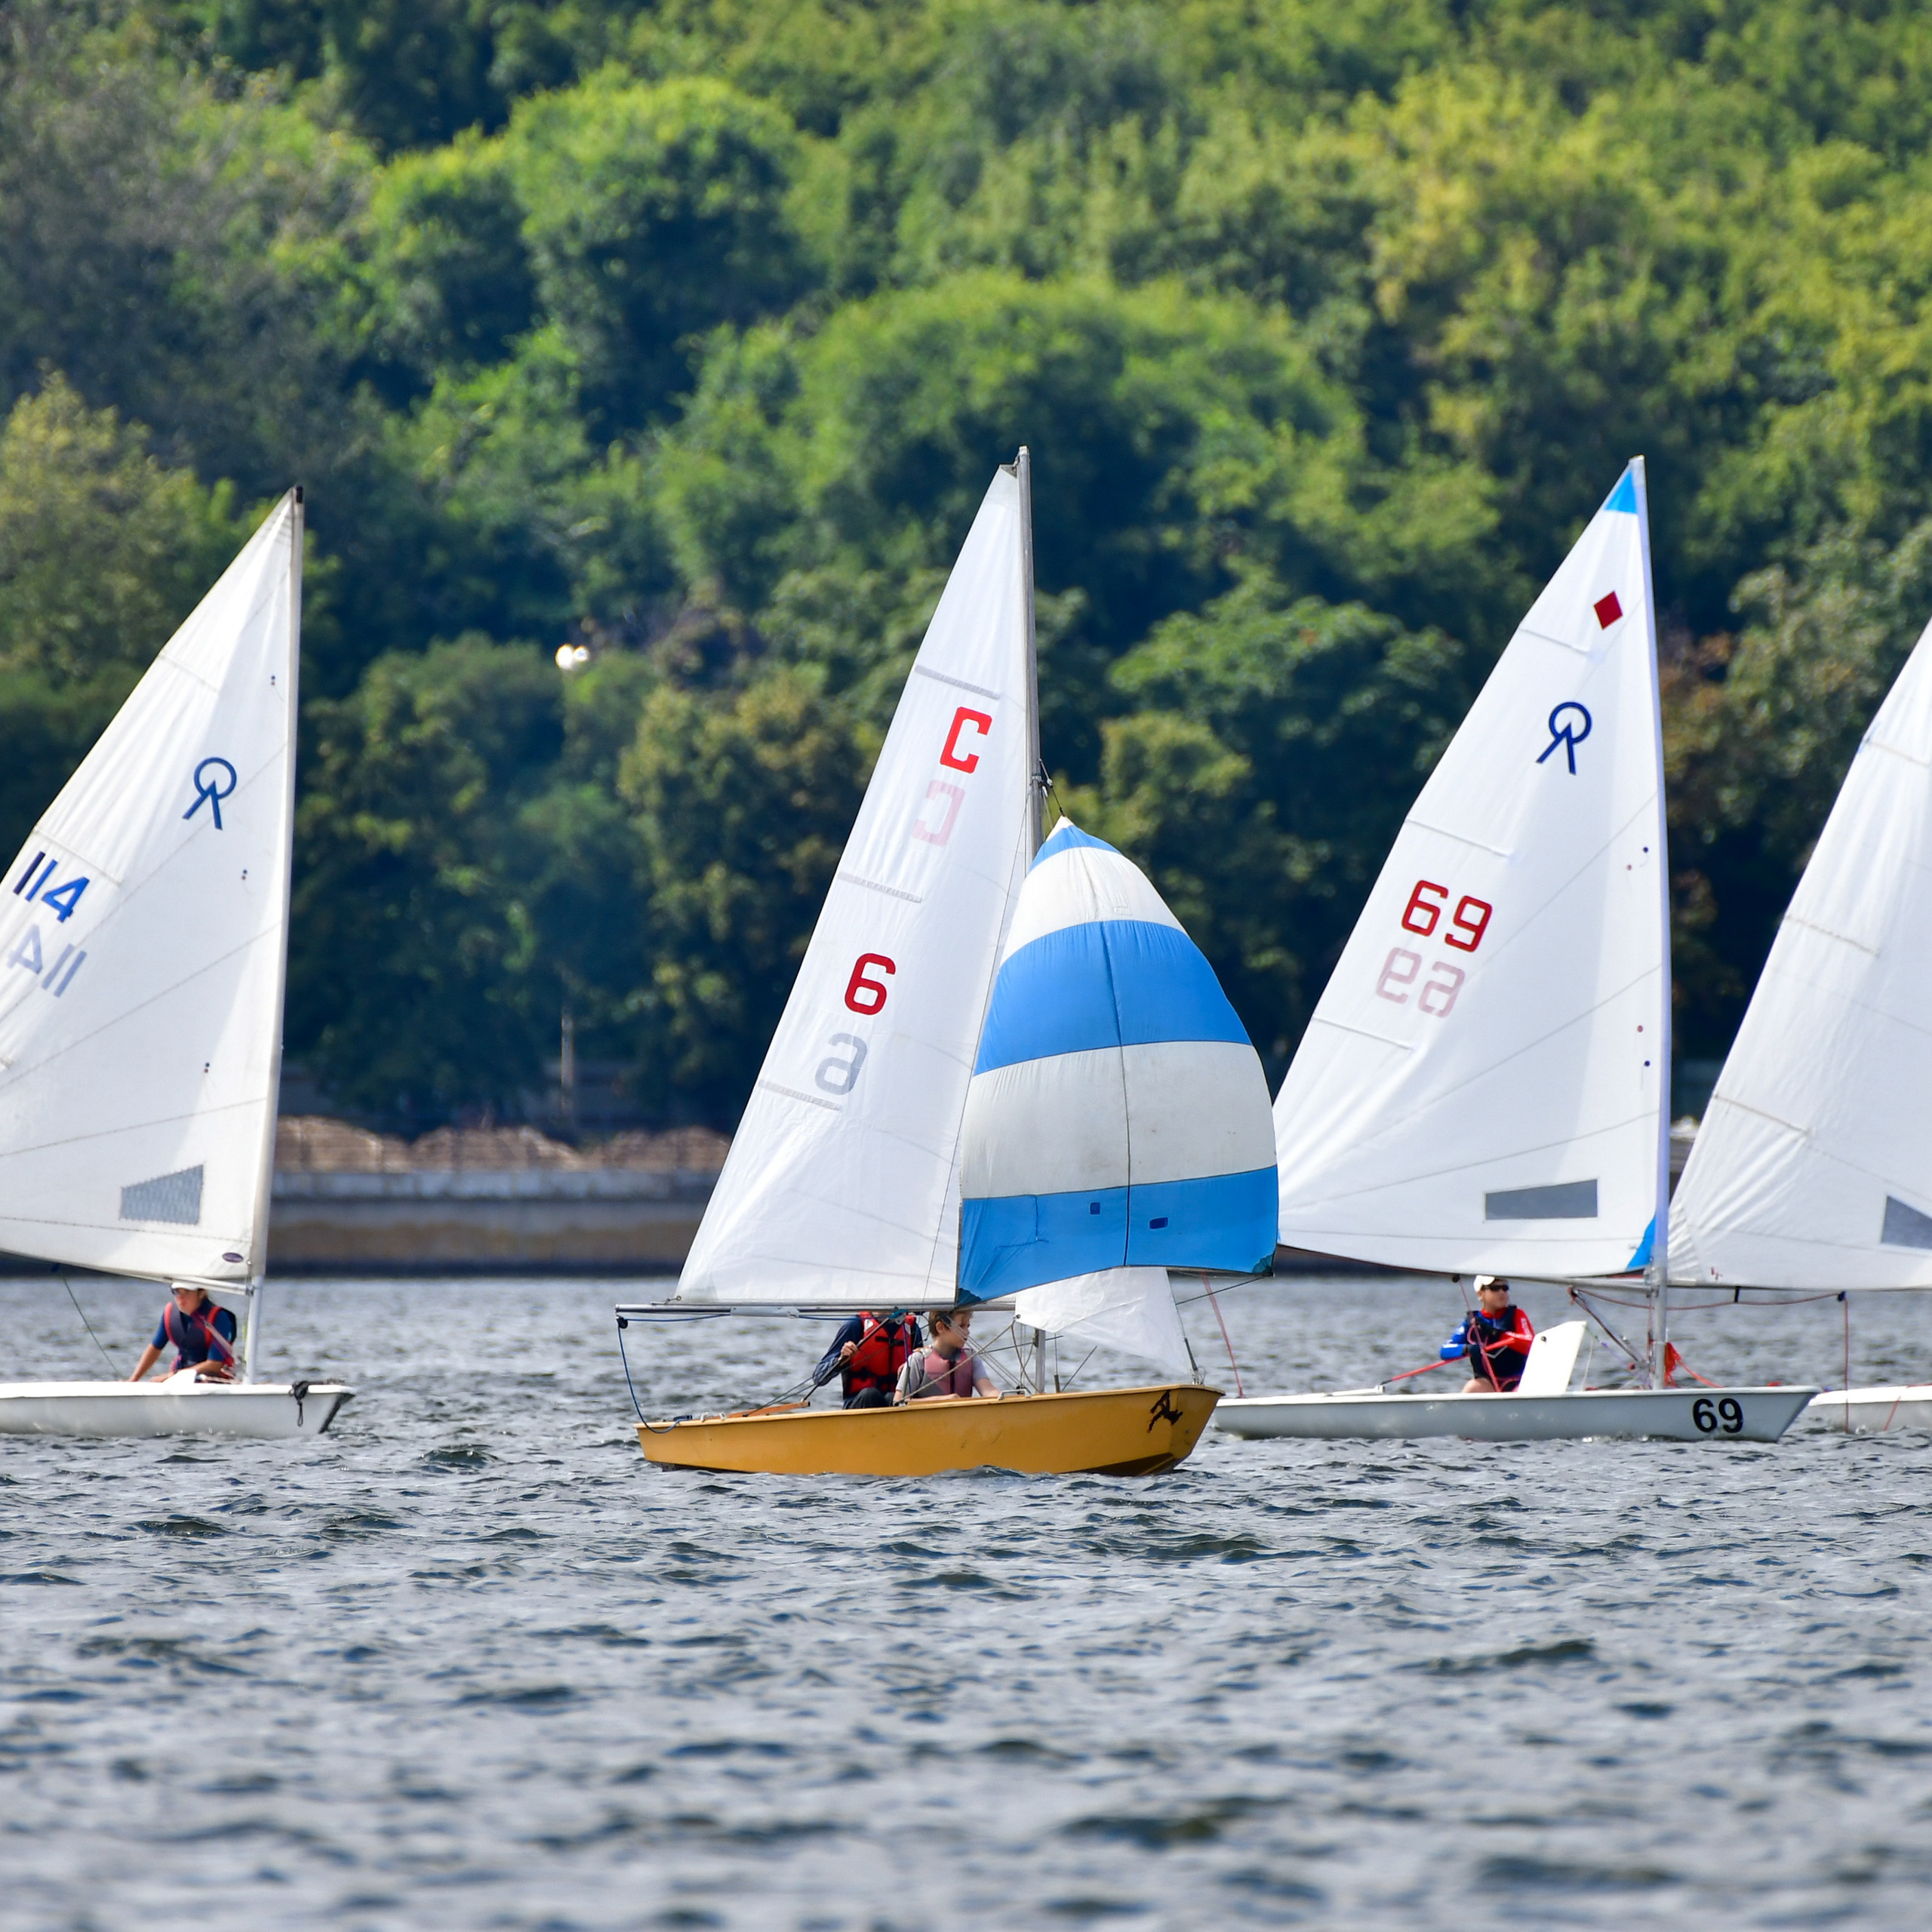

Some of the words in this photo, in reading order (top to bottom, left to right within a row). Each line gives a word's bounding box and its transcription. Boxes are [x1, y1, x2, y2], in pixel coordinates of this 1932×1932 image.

[940, 706, 992, 774] C
[13, 851, 90, 923] 114
[1401, 880, 1493, 952] 69
[844, 952, 896, 1016] 6
[1692, 1398, 1744, 1434] 69
